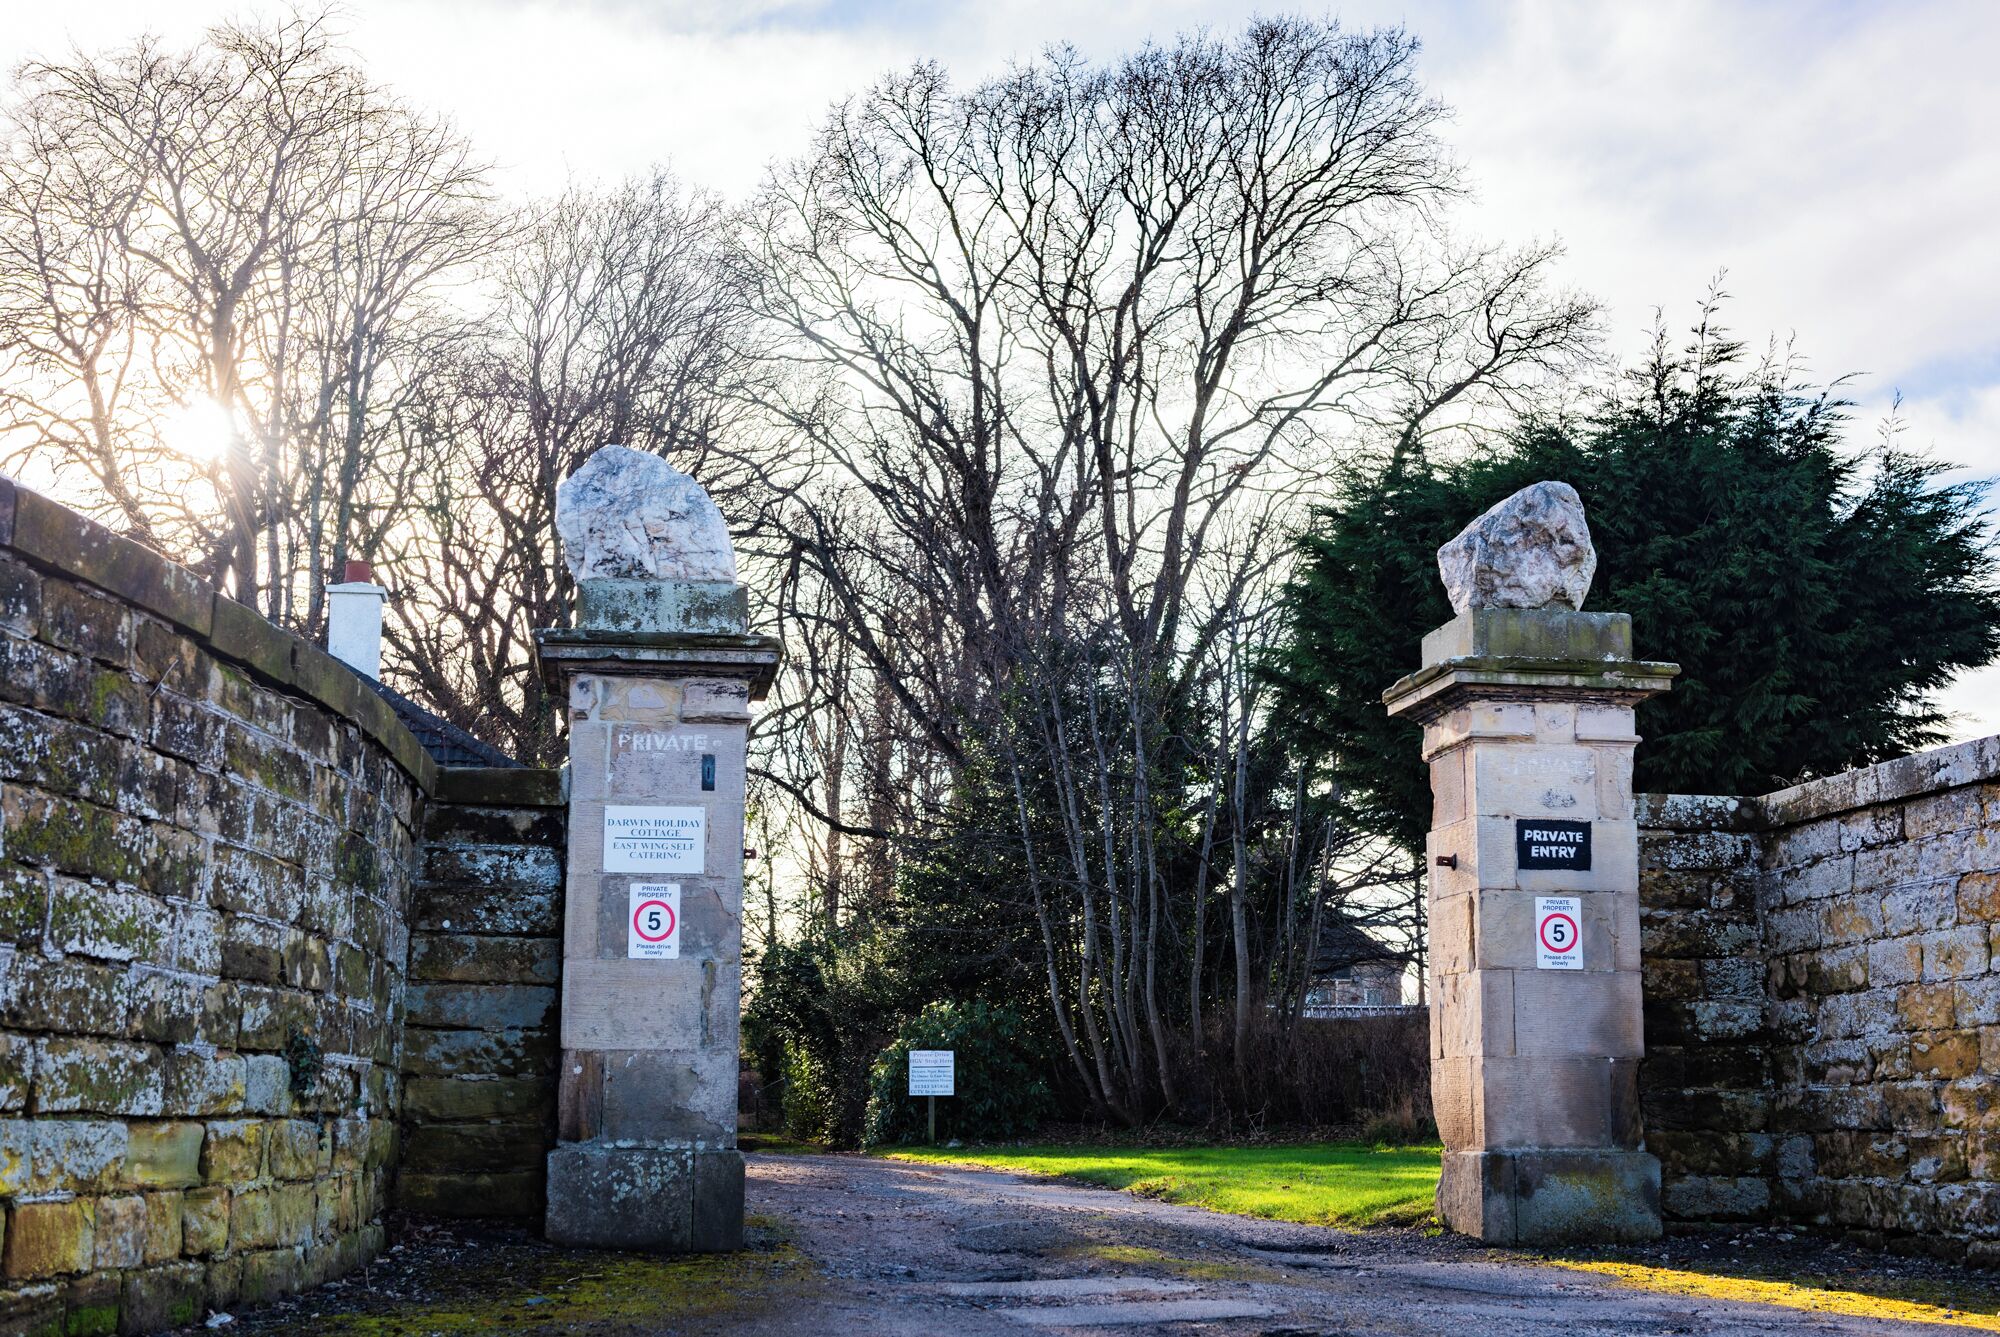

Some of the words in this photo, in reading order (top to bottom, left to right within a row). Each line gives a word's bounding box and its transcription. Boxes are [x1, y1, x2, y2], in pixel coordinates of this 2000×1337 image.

[618, 733, 708, 751] PRIVATE
[607, 818, 651, 827] DARWIN
[654, 819, 701, 828] HOLIDAY
[630, 828, 682, 837] COTTAGE
[1524, 829, 1584, 843] PRIVATE
[613, 842, 638, 850] EAST
[641, 842, 669, 851] WING
[670, 843, 696, 851] SELF
[1531, 845, 1577, 859] ENTRY
[629, 851, 682, 860] CATERING
[648, 911, 661, 931] 5
[1553, 923, 1565, 943] 5
